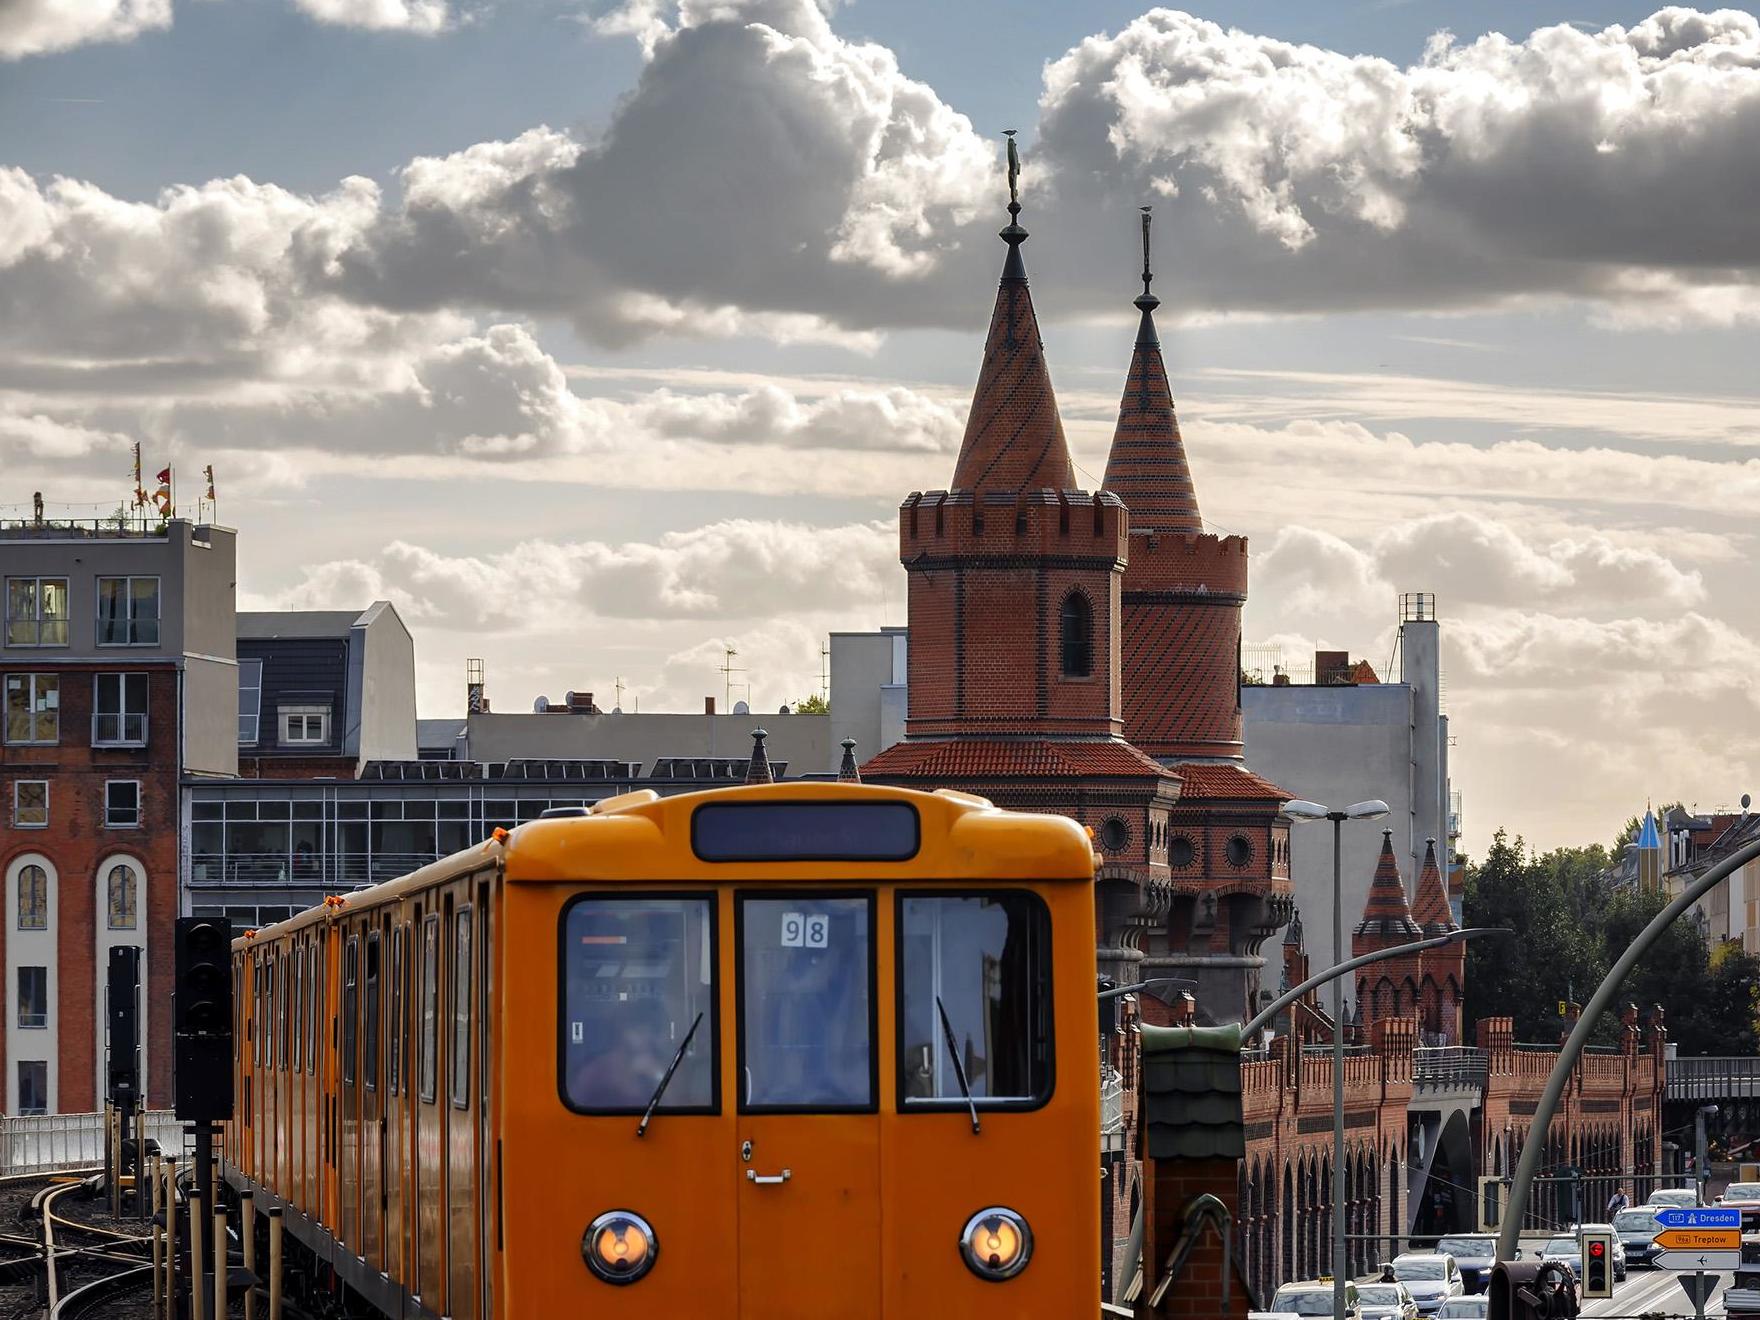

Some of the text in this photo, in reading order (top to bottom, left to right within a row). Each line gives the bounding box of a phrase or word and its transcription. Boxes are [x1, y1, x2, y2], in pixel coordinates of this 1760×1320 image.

[787, 921, 824, 943] 98
[1700, 1214, 1735, 1222] Dresden
[1693, 1235, 1727, 1245] Treptow
